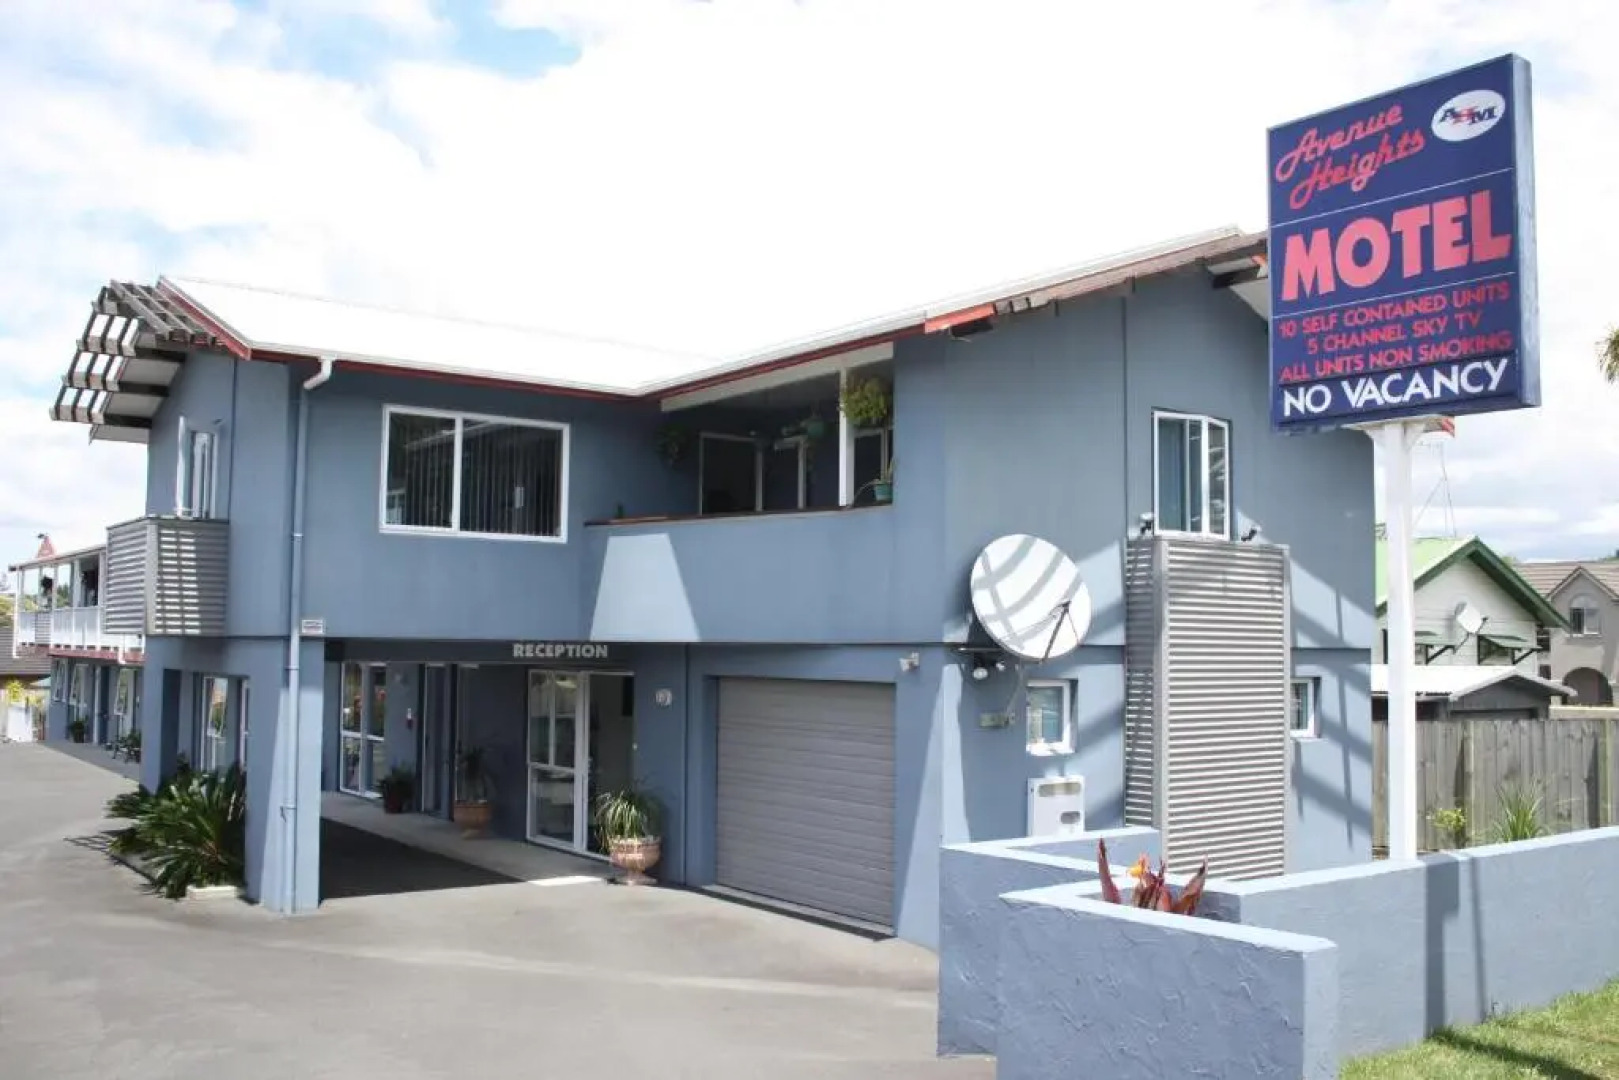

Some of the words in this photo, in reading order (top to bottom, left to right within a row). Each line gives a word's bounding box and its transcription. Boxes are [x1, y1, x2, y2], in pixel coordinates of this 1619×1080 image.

[1275, 104, 1403, 182] Avenue
[1290, 129, 1426, 209] Heights
[1282, 190, 1512, 300] MOTEL
[1279, 319, 1297, 338] 10
[1302, 312, 1338, 333] SELF
[1343, 293, 1447, 326] CONTAINED
[1453, 281, 1509, 308] UNITS
[1307, 338, 1318, 354] 5
[1324, 324, 1407, 352] CHANNEL
[1412, 315, 1448, 338] SKY
[1455, 310, 1482, 330] TV
[1279, 360, 1310, 382] ALL
[1315, 353, 1364, 377] UNITS
[1369, 346, 1412, 369] NON
[1418, 330, 1512, 361] SMOKING
[1284, 384, 1332, 416] NO
[1341, 358, 1507, 409] VACANCY
[512, 643, 608, 658] RECEPTION
